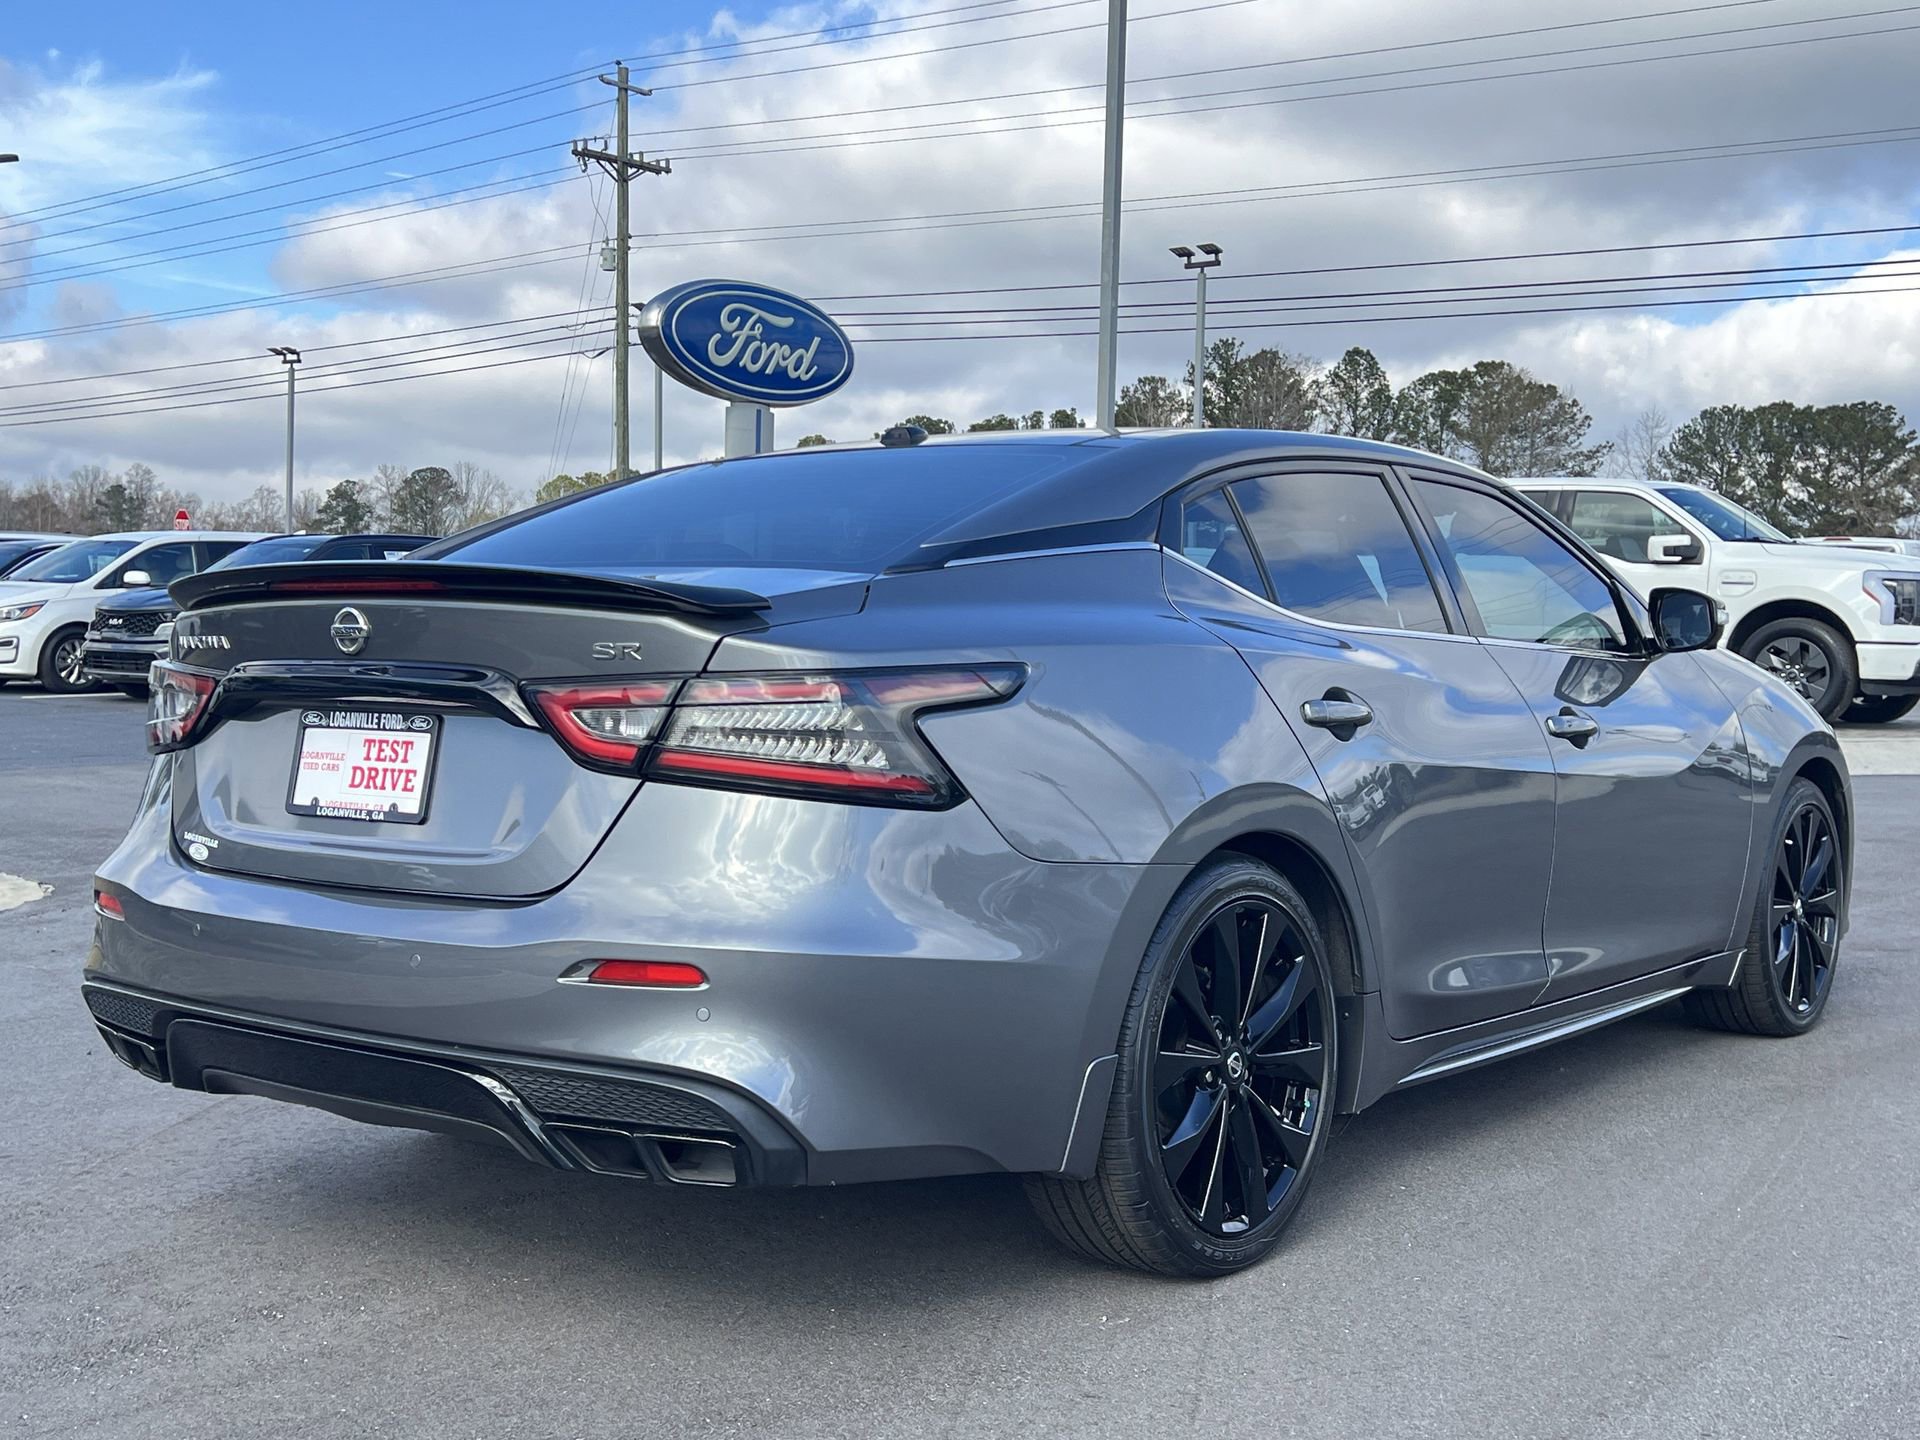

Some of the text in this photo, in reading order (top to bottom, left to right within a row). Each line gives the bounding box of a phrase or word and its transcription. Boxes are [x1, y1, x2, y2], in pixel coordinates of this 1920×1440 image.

[707, 302, 822, 382] Ford
[175, 519, 190, 530] STOP
[592, 642, 642, 660] SR
[329, 711, 403, 730] LOGANVILLE FORD
[301, 750, 346, 762] LOGANVILLE
[363, 738, 414, 763] TEST
[303, 762, 340, 772] USED CARS
[348, 765, 417, 792] DRIVE
[316, 807, 384, 820] LOGANVILLE, GA
